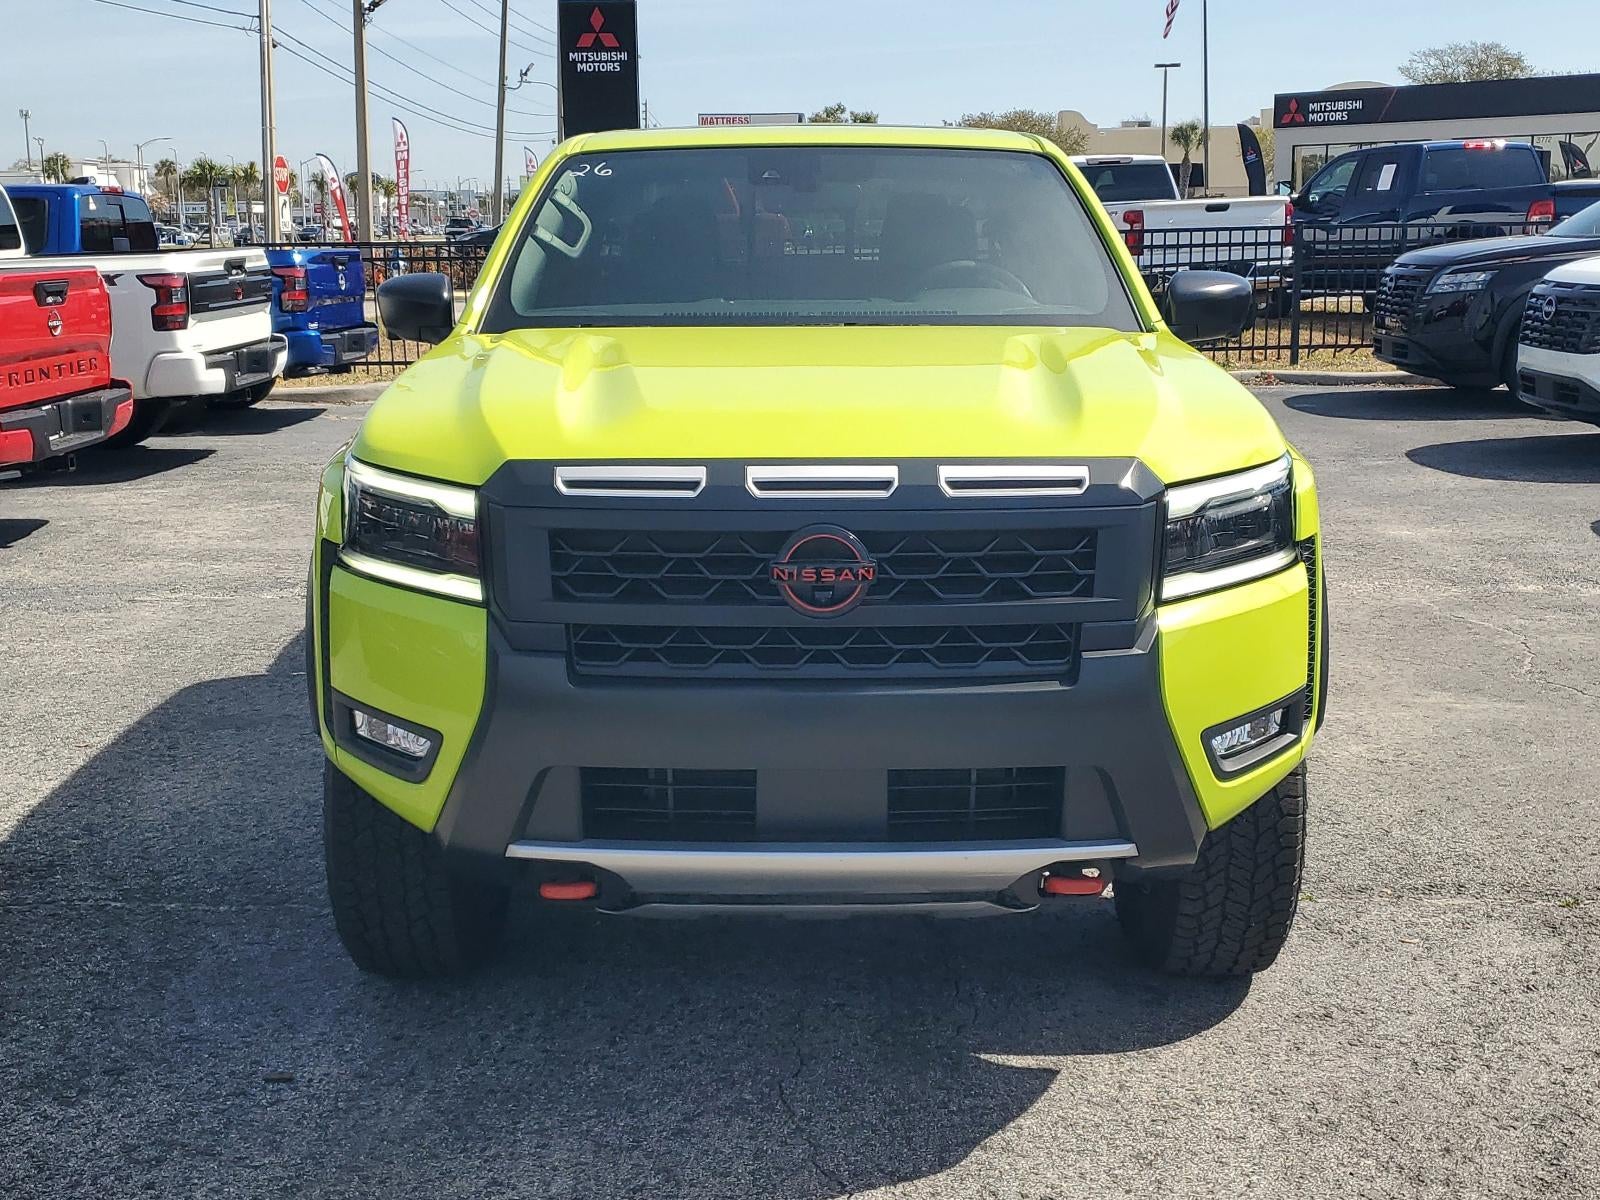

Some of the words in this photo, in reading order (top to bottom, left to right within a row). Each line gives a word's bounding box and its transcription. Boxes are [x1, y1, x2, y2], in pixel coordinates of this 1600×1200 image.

[569, 51, 628, 61] MITSUBISHI
[577, 62, 620, 72] MOTORS
[1309, 100, 1363, 112] MITSUBISHI
[701, 116, 750, 126] MATTRESS
[1308, 111, 1348, 122] MOTORS
[275, 167, 288, 182] STOP
[569, 162, 613, 177] 26
[773, 567, 874, 581] NISSAN
